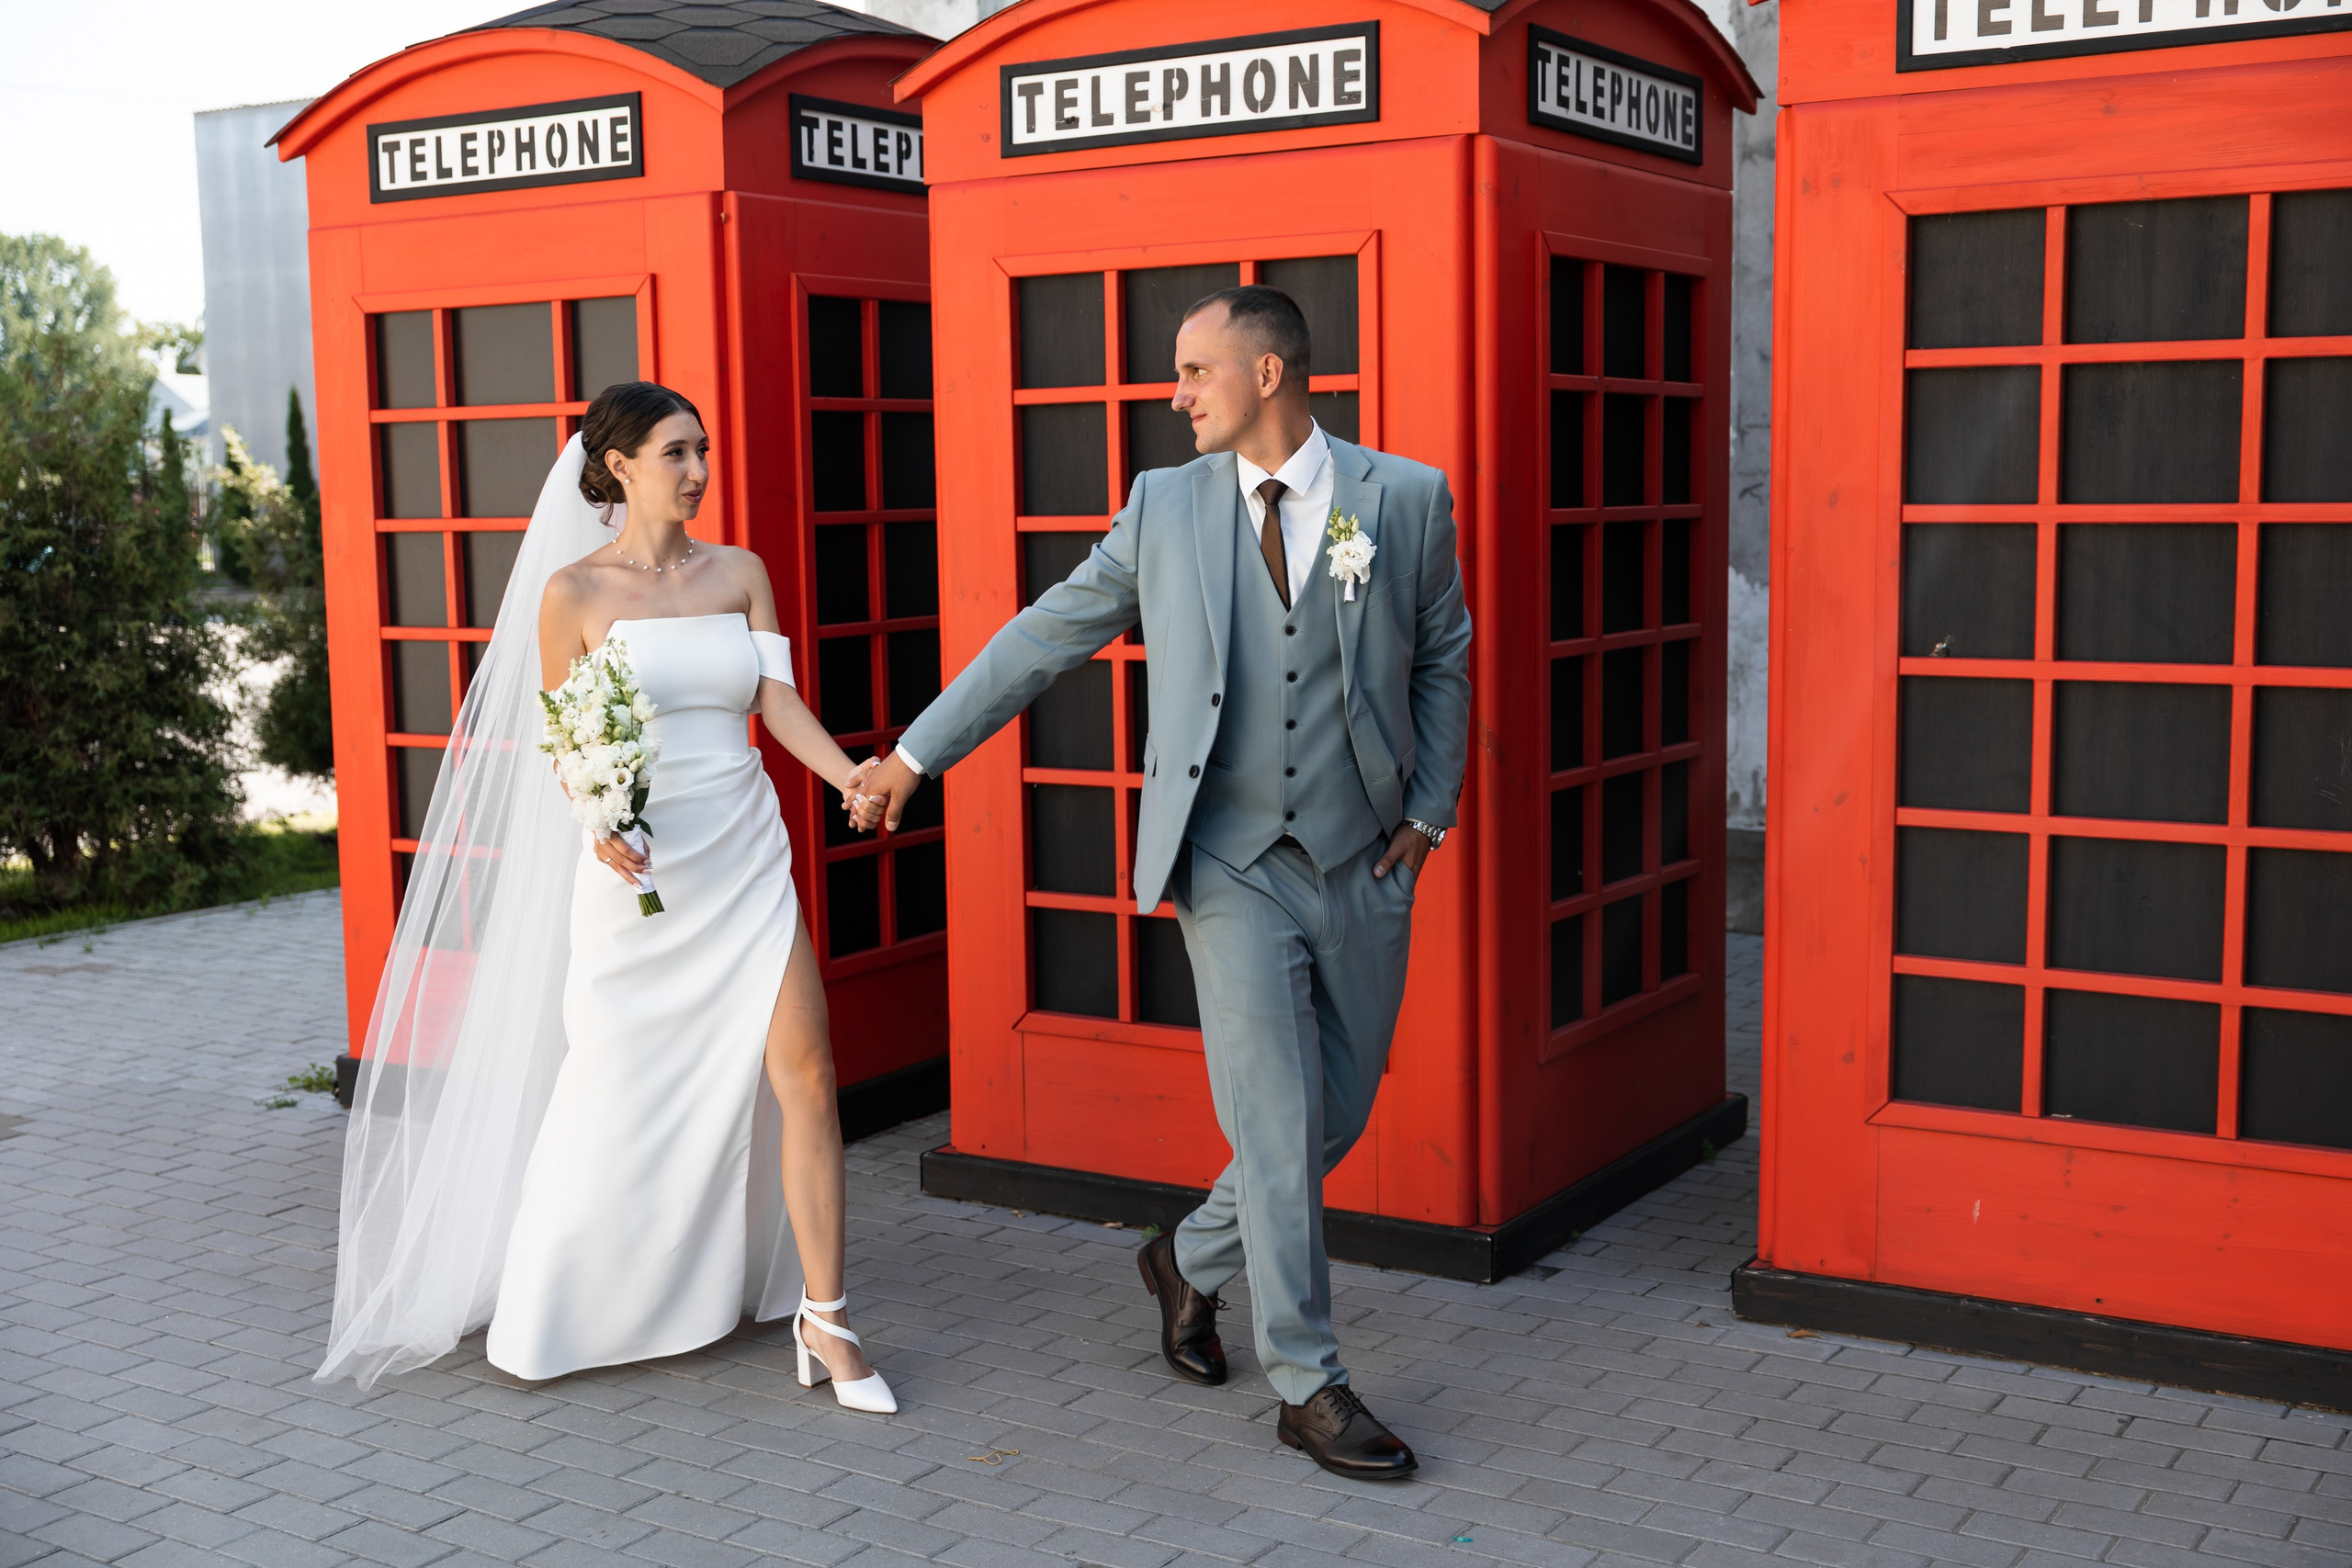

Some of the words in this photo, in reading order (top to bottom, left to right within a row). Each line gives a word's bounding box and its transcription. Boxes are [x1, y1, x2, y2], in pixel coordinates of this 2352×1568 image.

[1018, 49, 1362, 133] TELEPHONE
[1538, 47, 1692, 146] TELEPHONE
[382, 116, 629, 184] TELEPHONE
[801, 116, 923, 178] TELEP
